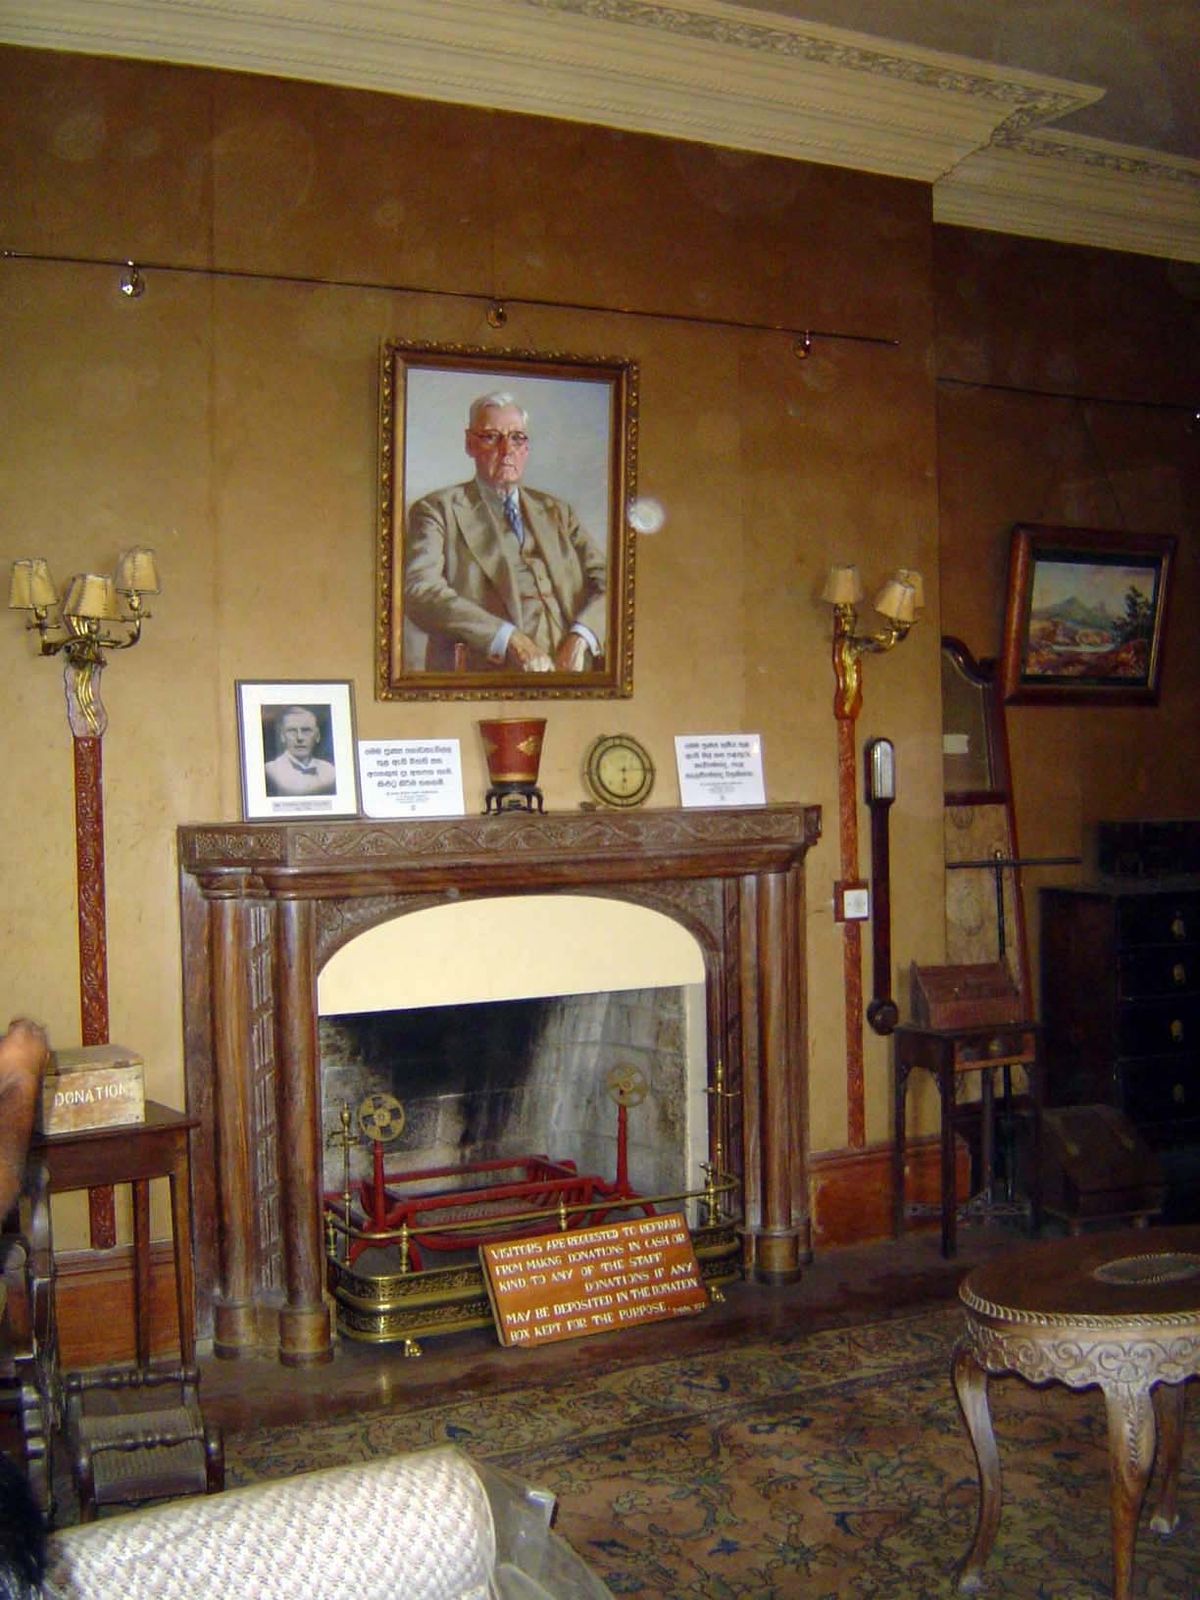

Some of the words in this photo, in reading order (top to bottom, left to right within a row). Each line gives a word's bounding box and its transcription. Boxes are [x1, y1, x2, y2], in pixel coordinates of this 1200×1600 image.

[491, 1243, 543, 1260] VISITORS
[547, 1238, 565, 1251] ARE
[567, 1230, 619, 1248] REQUESTED
[622, 1227, 637, 1236] TO
[495, 1263, 523, 1276] FROM
[568, 1245, 624, 1263] DONATIONS
[628, 1241, 641, 1252] IN
[644, 1236, 670, 1248] CASH
[672, 1233, 686, 1243] OR
[499, 1278, 526, 1293] KIND
[530, 1275, 546, 1285] TO
[551, 1269, 573, 1282] ANY
[581, 1265, 595, 1277] OF
[600, 1259, 624, 1272] THE
[629, 1252, 663, 1266] STAFF
[585, 1271, 649, 1293] DONATIONS
[654, 1267, 664, 1278] IF
[670, 1262, 693, 1275] ANY
[506, 1309, 531, 1325] MAY
[535, 1306, 550, 1319] BE
[554, 1295, 613, 1316] DEPOSITED
[616, 1292, 629, 1302] IN
[630, 1287, 651, 1300] THE
[652, 1278, 698, 1295] DONATION
[510, 1328, 530, 1342] BOX
[534, 1322, 562, 1337] KEPT
[567, 1317, 588, 1331] FOR
[591, 1312, 614, 1325] THE
